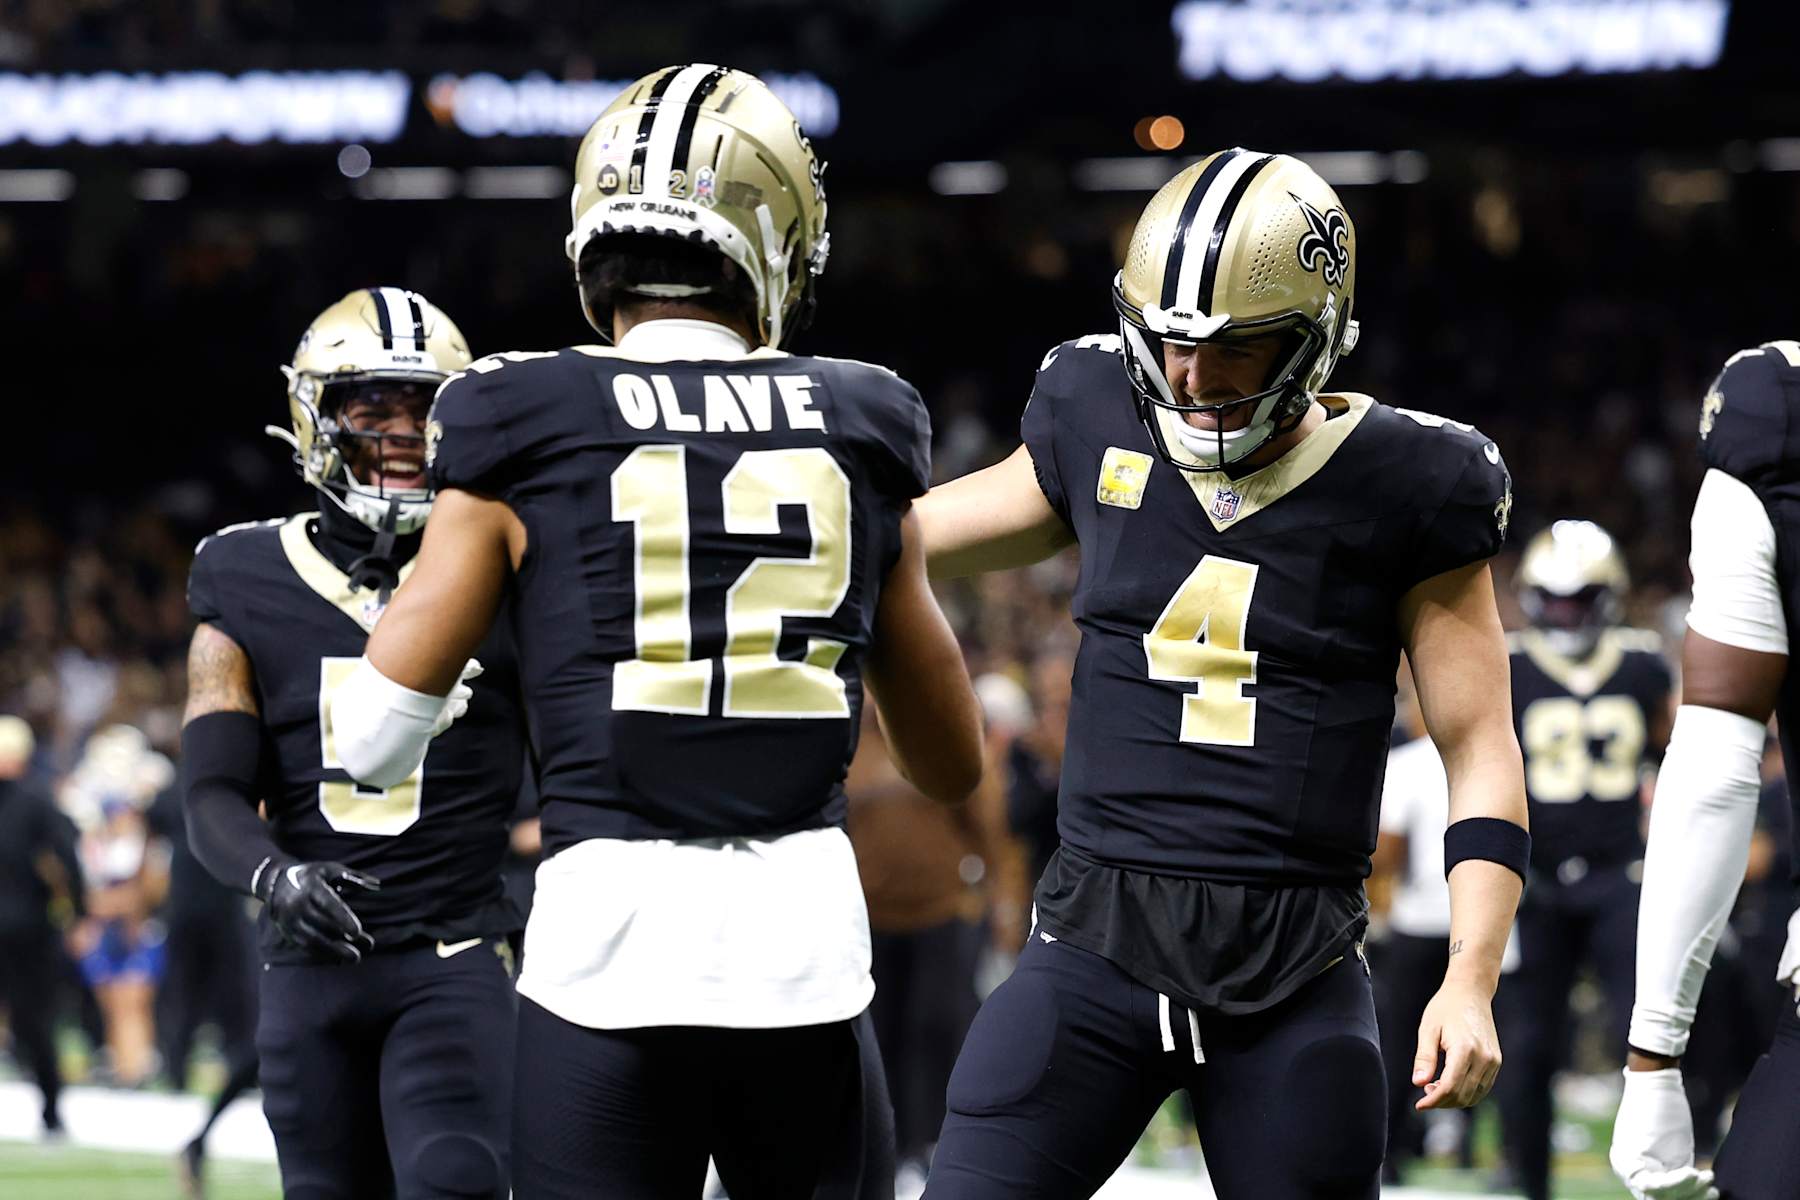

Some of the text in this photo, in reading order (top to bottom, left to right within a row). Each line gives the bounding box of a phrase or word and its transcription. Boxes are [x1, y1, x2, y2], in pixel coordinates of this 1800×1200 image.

[609, 202, 697, 221] NEW ORLEANS
[612, 373, 826, 433] OLAVE
[610, 444, 851, 719] 12
[1142, 554, 1259, 747] 4
